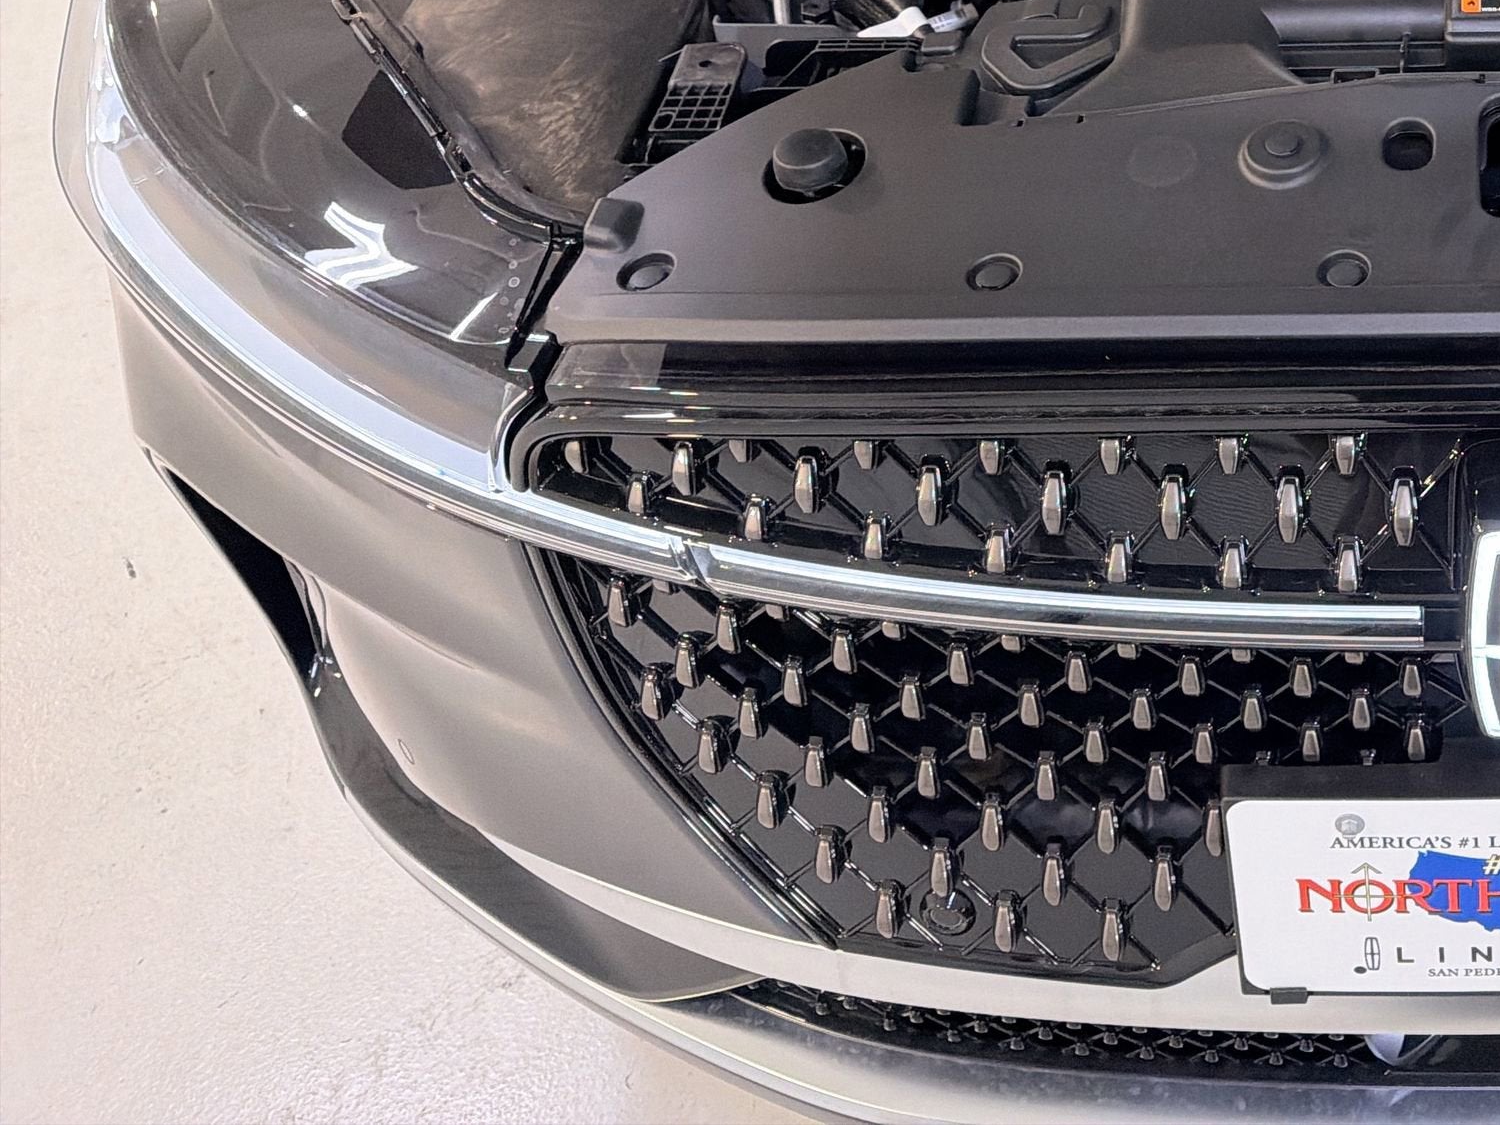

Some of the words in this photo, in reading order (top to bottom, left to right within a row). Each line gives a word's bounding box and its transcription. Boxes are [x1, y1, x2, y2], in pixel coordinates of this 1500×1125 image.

[1330, 835, 1452, 850] AMERICA'S
[1458, 836, 1481, 849] #1
[1428, 967, 1459, 977] SAN
